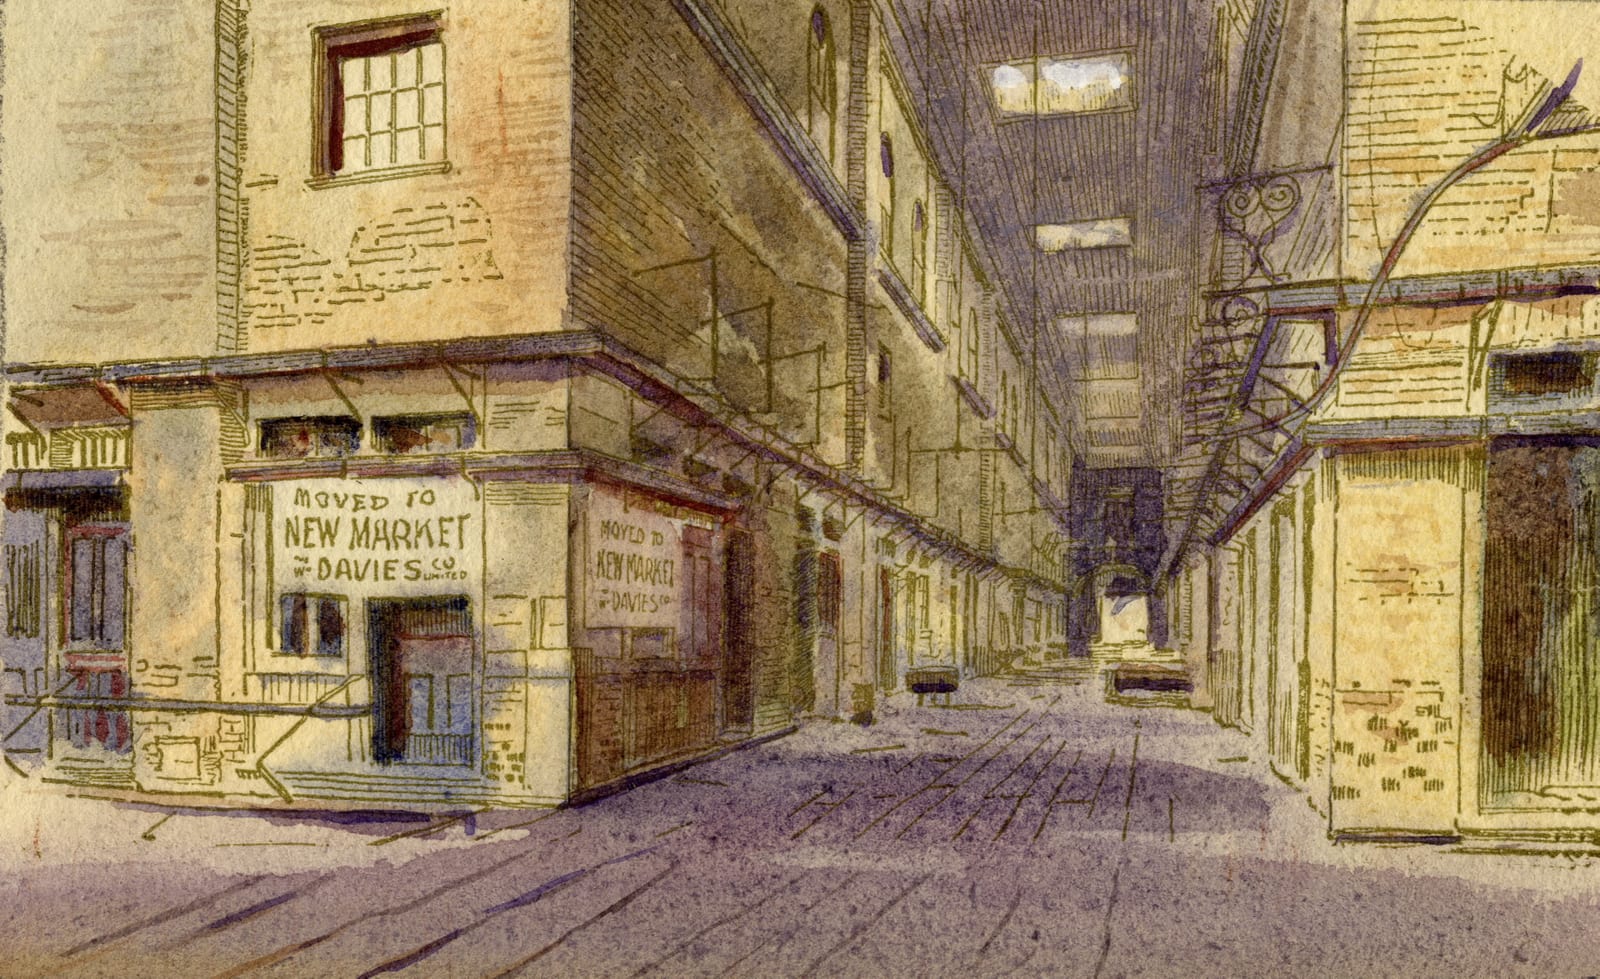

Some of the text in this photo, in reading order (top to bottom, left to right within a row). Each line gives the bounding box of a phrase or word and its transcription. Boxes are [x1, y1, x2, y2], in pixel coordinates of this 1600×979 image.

[294, 487, 436, 512] MOVED TO
[285, 513, 472, 551] NEW MARKET
[651, 530, 664, 546] TO
[317, 556, 422, 582] DAVIES
[596, 549, 674, 588] NEW MARKET
[612, 590, 659, 613] DAVIES
